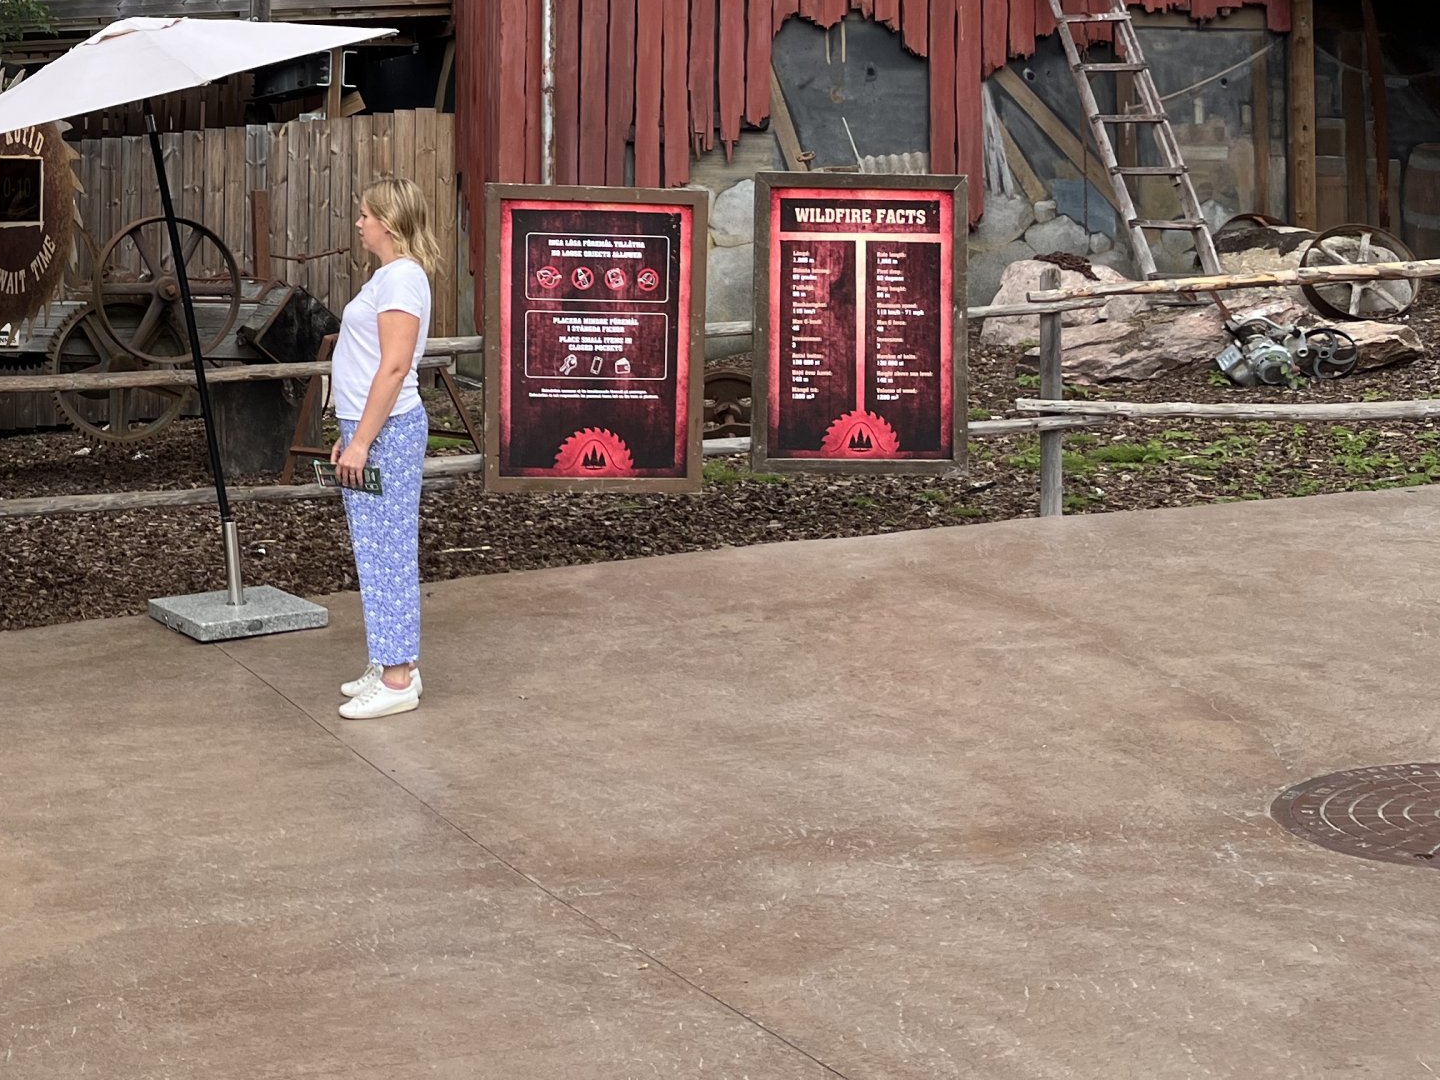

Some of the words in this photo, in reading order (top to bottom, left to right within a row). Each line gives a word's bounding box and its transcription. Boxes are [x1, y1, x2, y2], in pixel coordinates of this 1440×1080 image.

[795, 207, 876, 224] WILDFIRE
[876, 209, 926, 225] FACTS
[30, 234, 56, 282] TIME
[583, 250, 611, 258] OBJECTS
[612, 251, 643, 259] ALLOWED
[581, 336, 603, 344] SMALL
